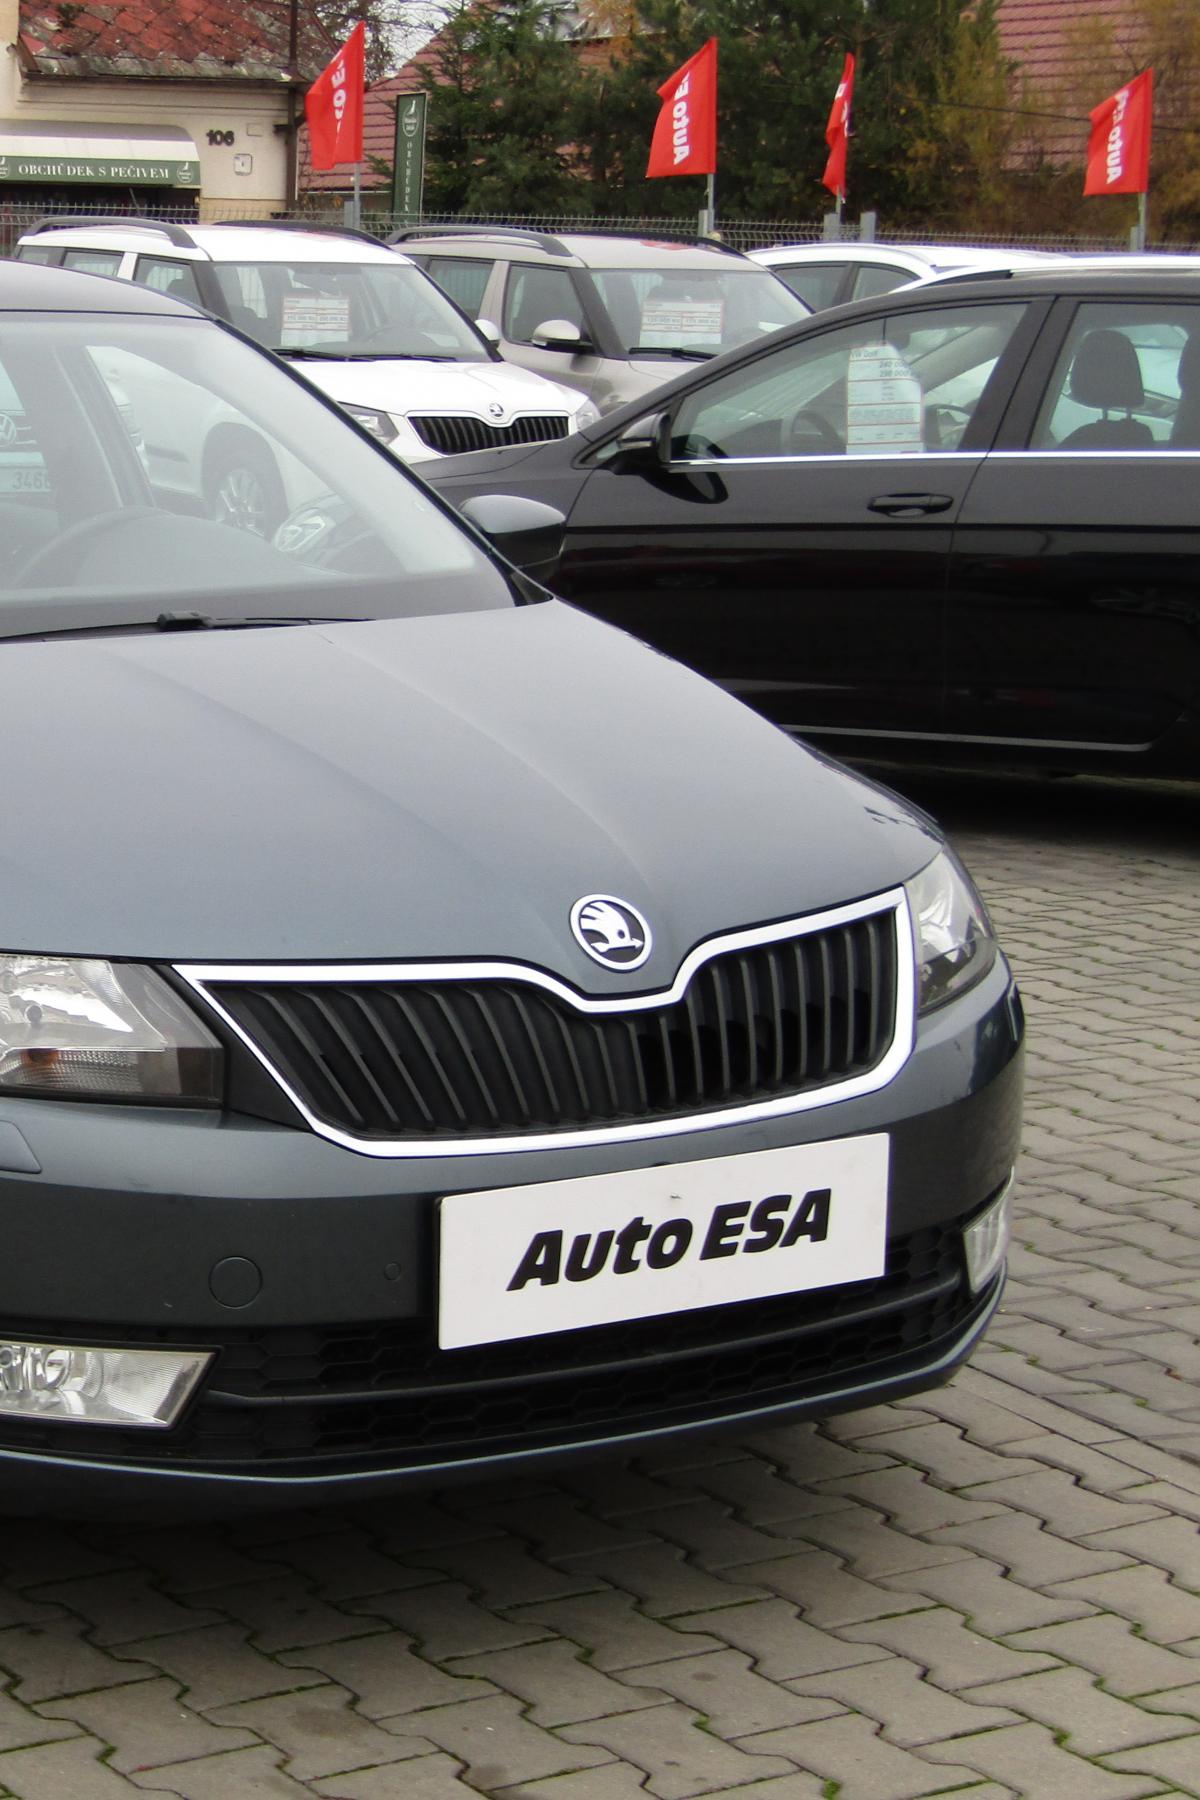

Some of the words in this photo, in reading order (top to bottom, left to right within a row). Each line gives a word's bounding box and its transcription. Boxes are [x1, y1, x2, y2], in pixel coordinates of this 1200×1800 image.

[206, 129, 235, 146] 106
[18, 163, 95, 177] OBCHŮDEK
[98, 168, 107, 177] S
[110, 165, 170, 179] PEČIVEM
[506, 1216, 693, 1291] Auto
[700, 1188, 832, 1260] ESA
